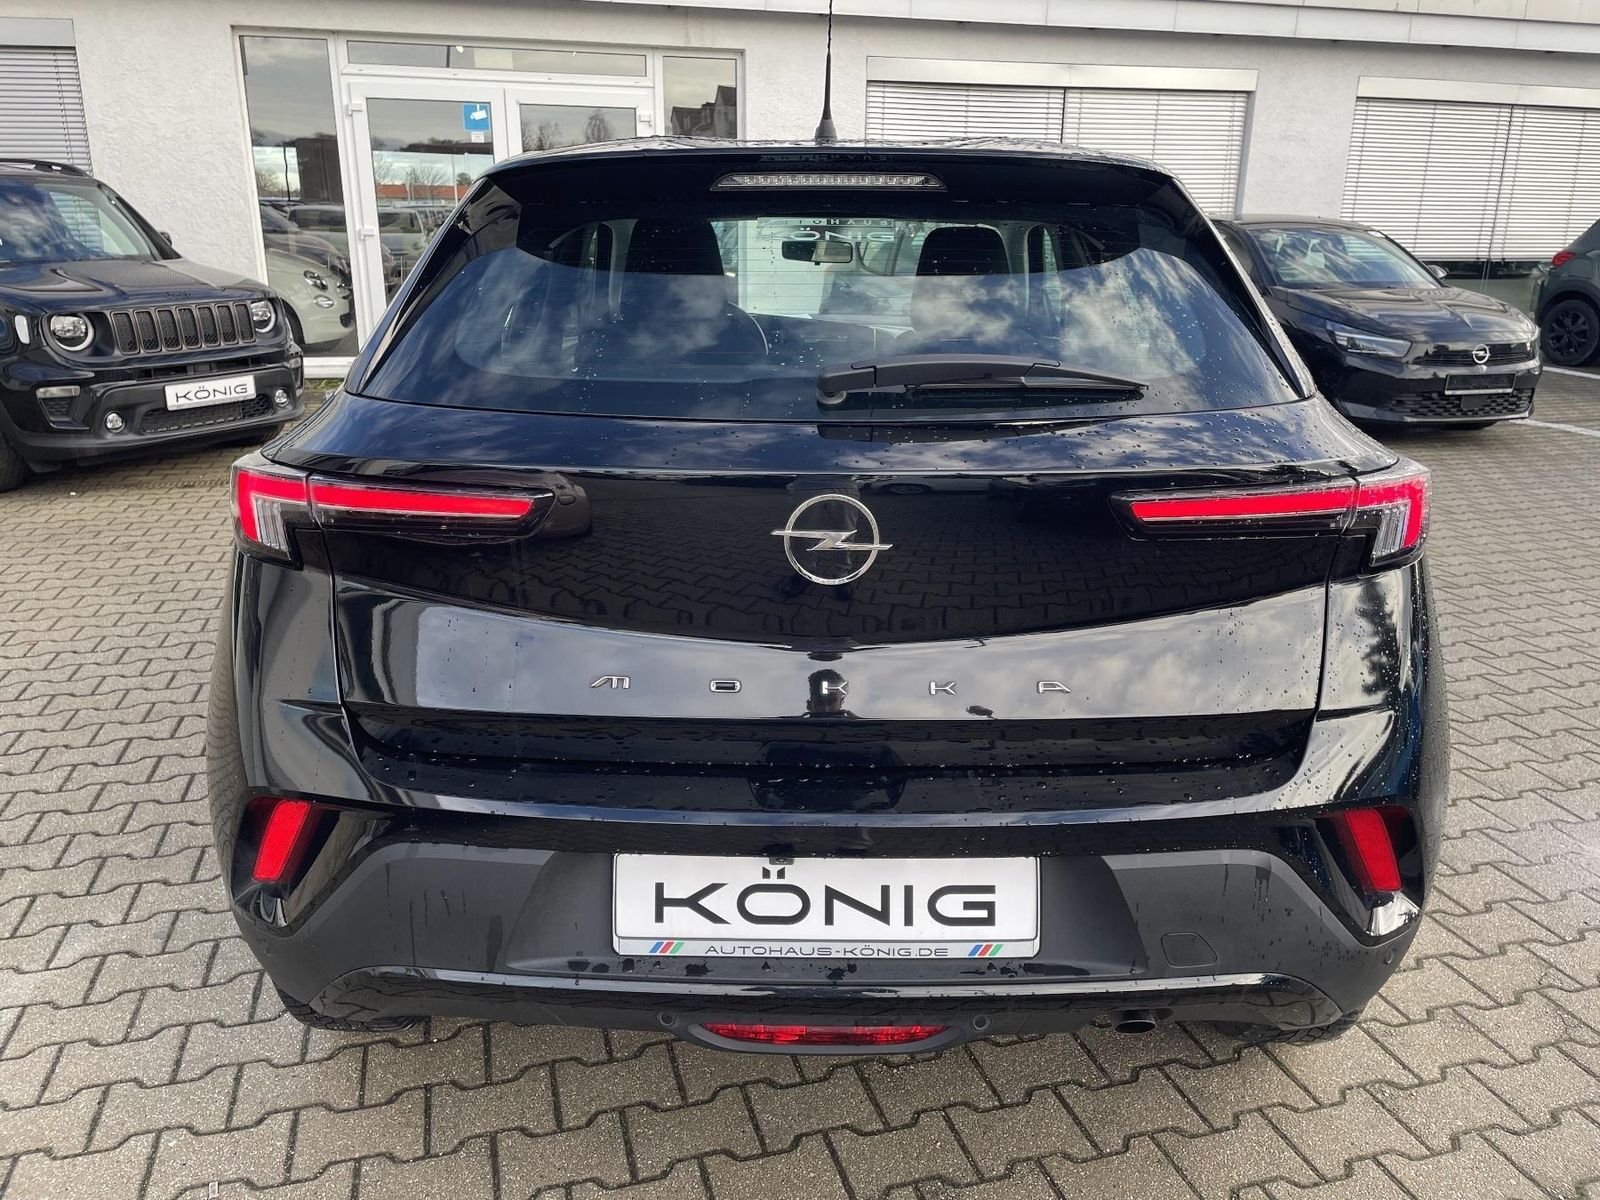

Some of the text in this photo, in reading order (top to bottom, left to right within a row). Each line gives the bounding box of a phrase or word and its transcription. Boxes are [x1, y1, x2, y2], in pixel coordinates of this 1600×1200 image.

[774, 227, 894, 241] ÖNIG
[175, 384, 248, 402] KÖNIG
[590, 675, 1072, 695] MOKKA
[654, 866, 996, 927] KÖNIG
[705, 944, 948, 957] AUTOHAUS-KÖNIG.DE
